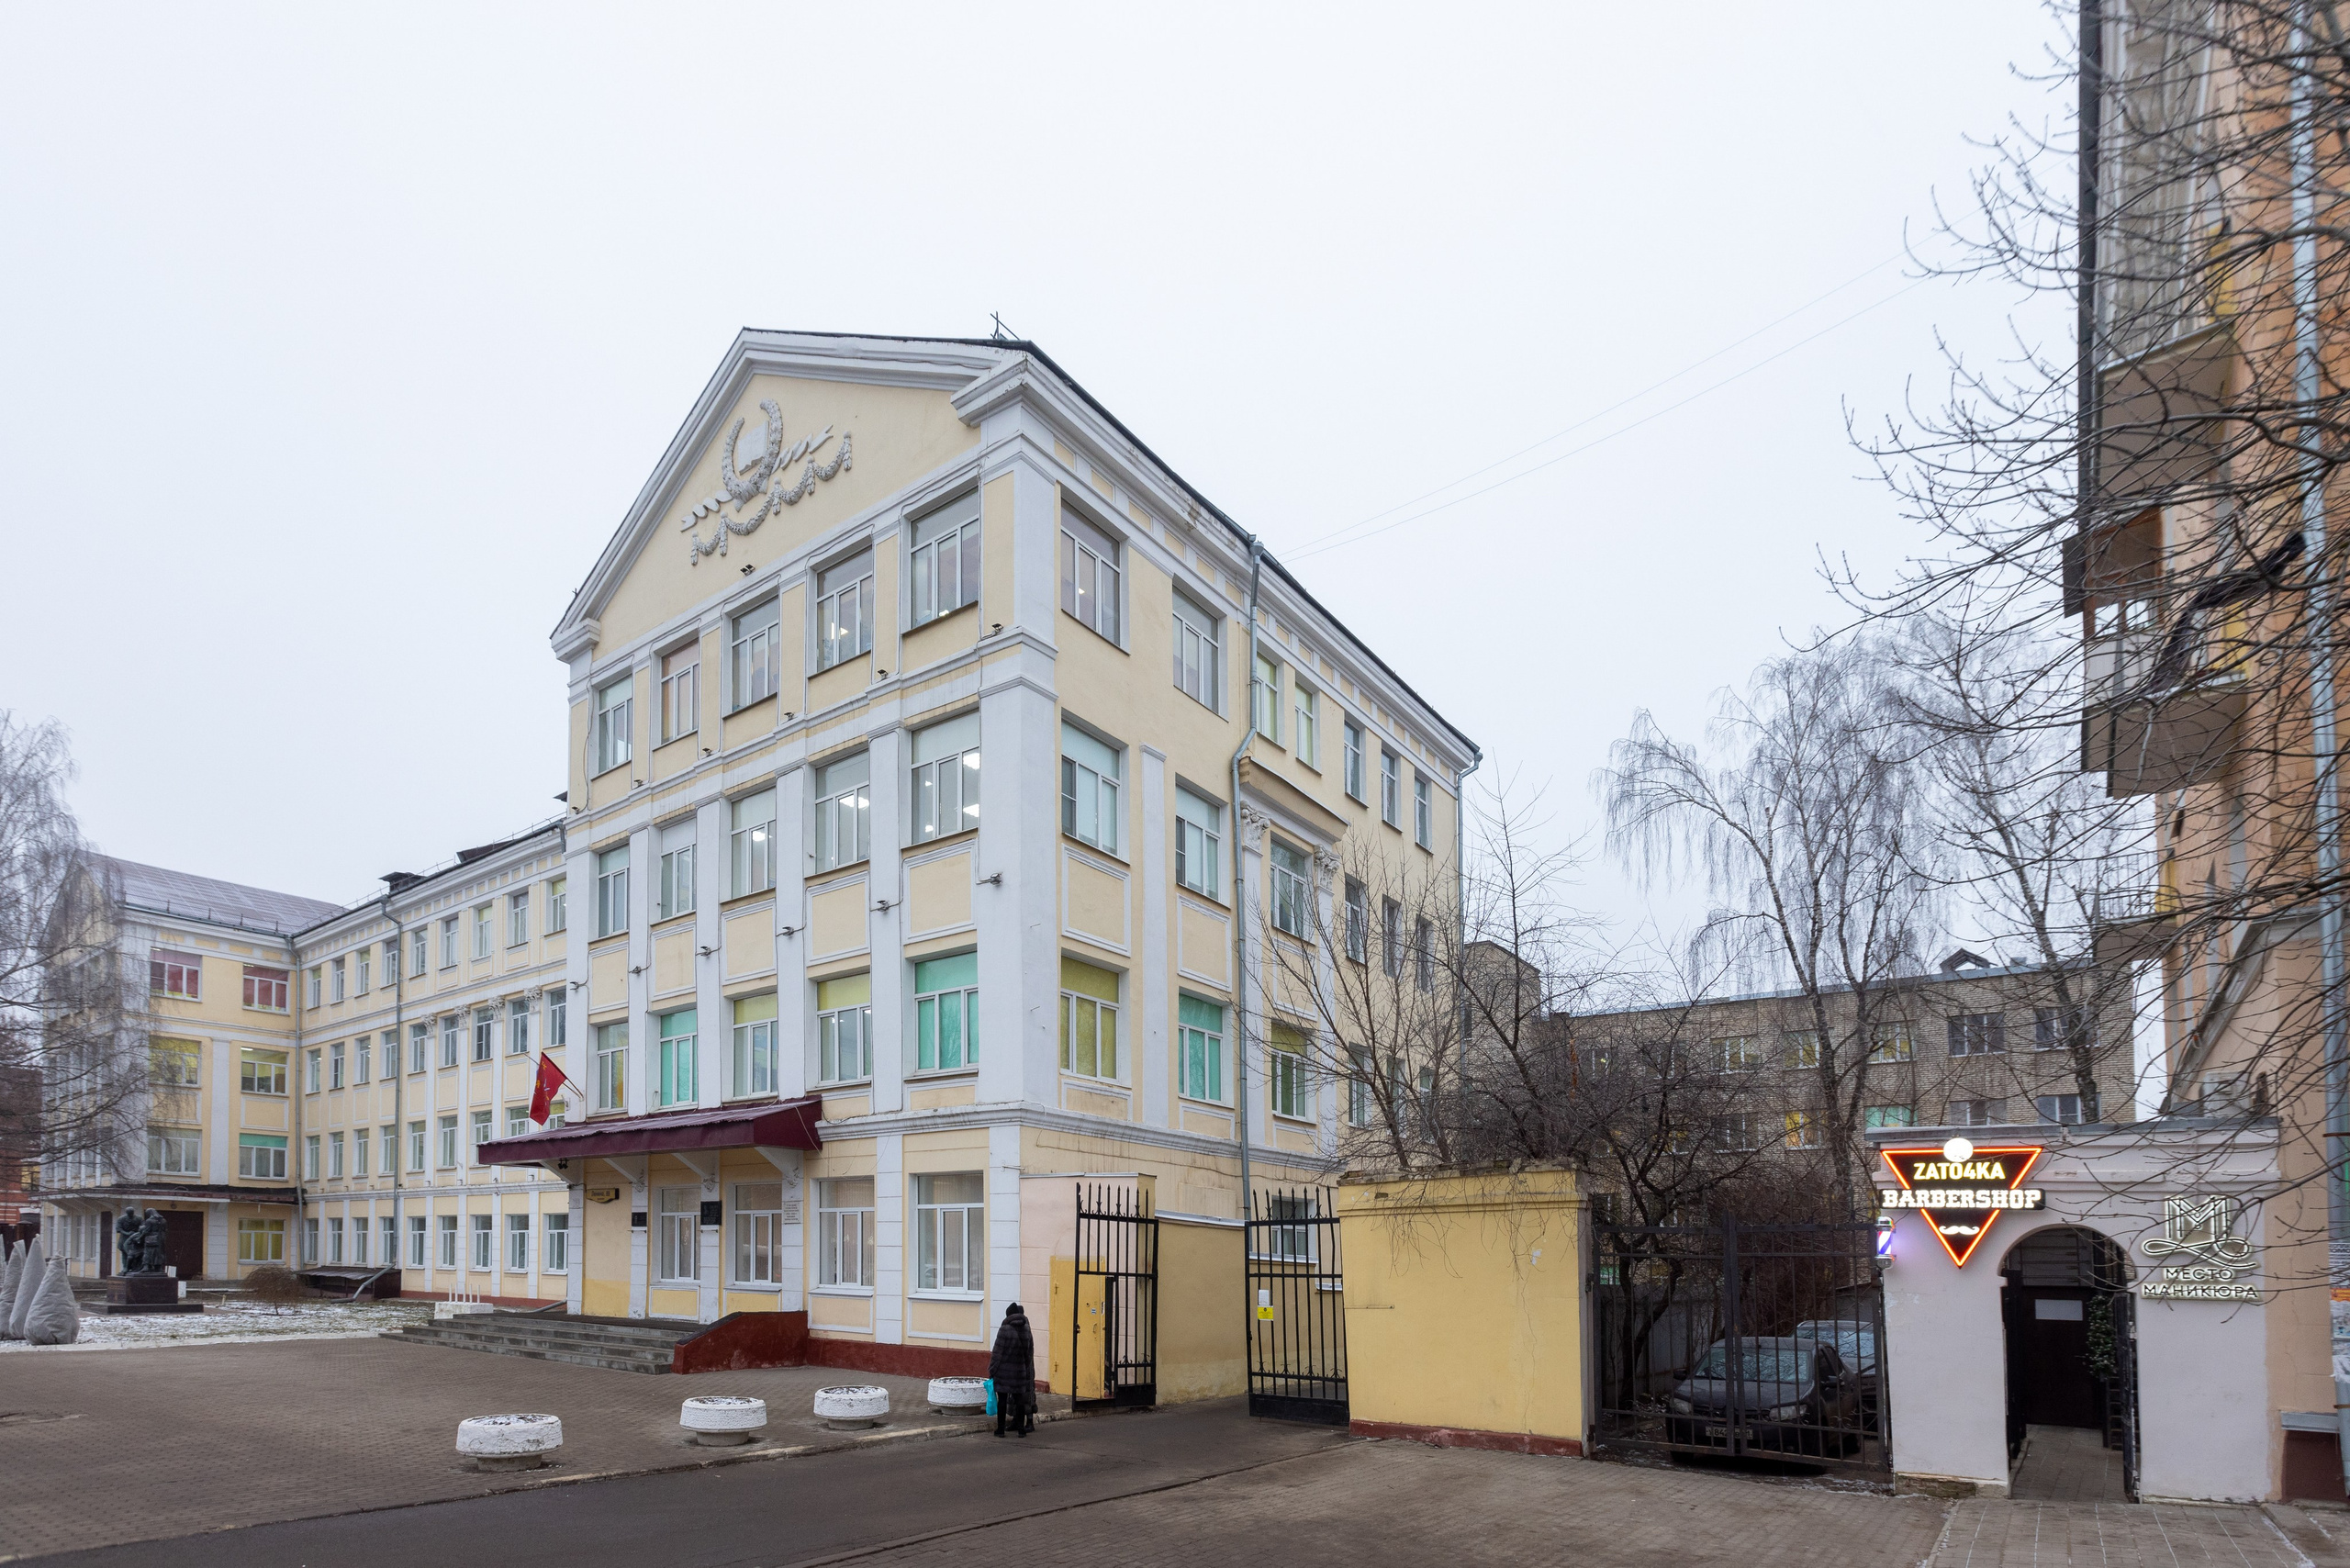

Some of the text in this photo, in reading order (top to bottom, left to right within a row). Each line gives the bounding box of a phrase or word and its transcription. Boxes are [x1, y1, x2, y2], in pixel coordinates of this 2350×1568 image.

[1913, 1162, 2006, 1180] ZATO4KA
[1882, 1189, 2042, 1209] BARBERSHOP
[2165, 1268, 2233, 1280] МЕСТО
[2143, 1284, 2258, 1298] МАНИКЮРА
